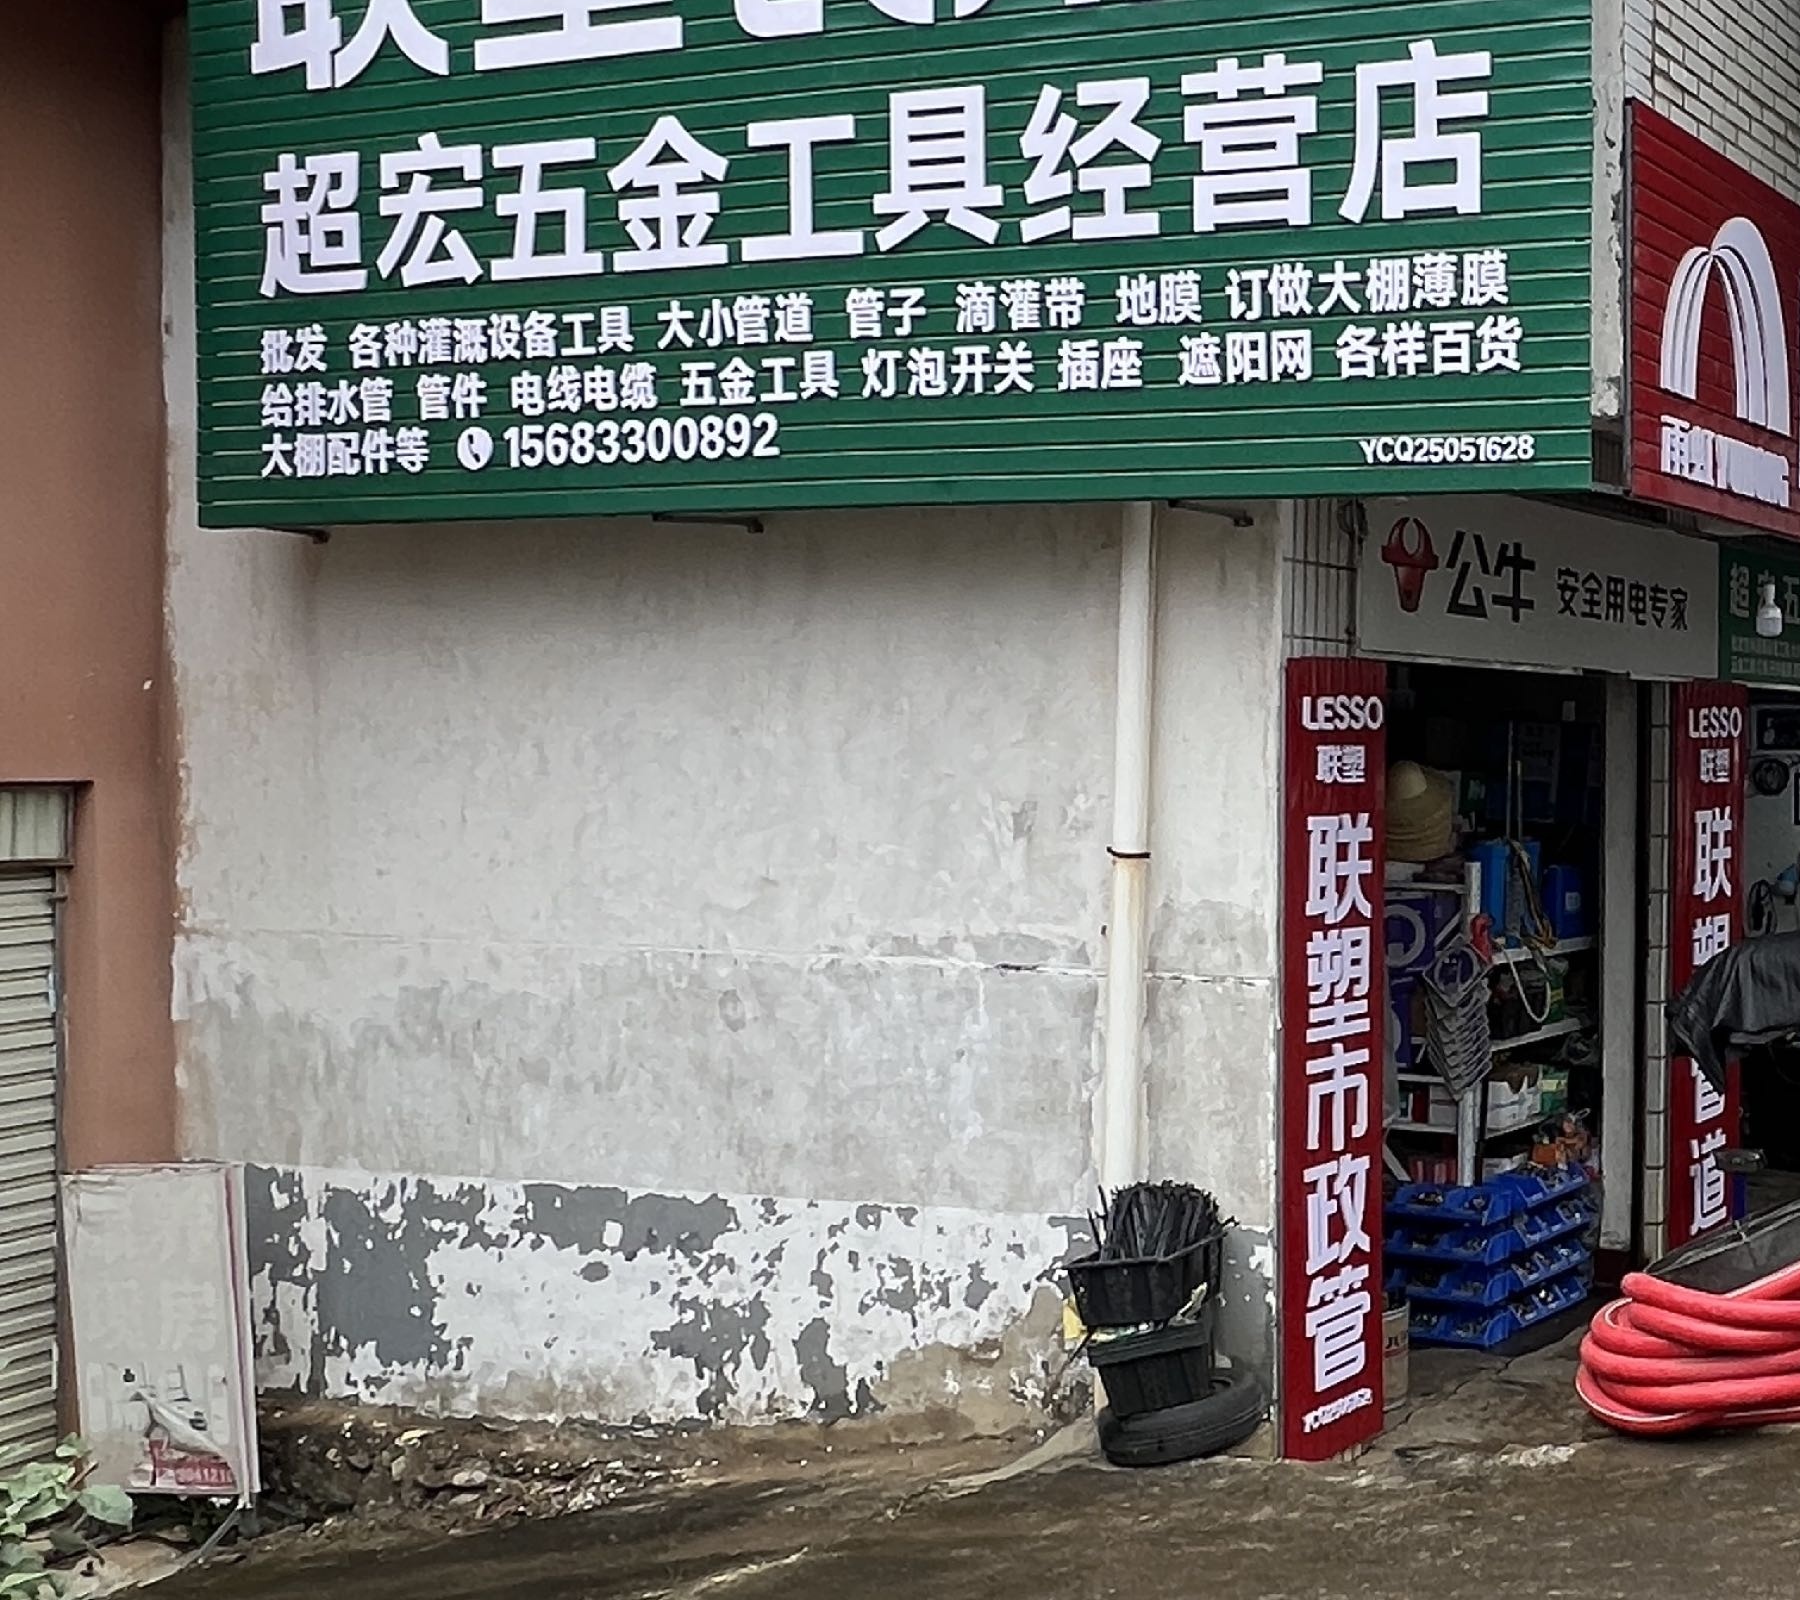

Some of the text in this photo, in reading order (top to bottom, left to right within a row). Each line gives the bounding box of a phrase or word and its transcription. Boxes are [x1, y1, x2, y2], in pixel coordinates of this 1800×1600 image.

[259, 38, 1491, 299] 超宏五金工具经营店
[261, 249, 1509, 374] 批发 各种灌溉设备工具 大小管道 管子 滴灌带 地膜 订做大棚薄膜
[261, 316, 1524, 427] 给排水管 管件 电线电缆 五金工具 灯泡开关 插座 遮阳网 各样百货
[261, 413, 781, 477] 大棚配件等 15683300892
[1360, 434, 1535, 466] YCQ25051628
[1446, 530, 1689, 631] 公牛 安全用电专家
[1302, 695, 1383, 732] LESSO
[1688, 706, 1743, 740] LESSO
[1316, 745, 1366, 785] 联塑
[1305, 813, 1374, 1393] 联塑市政管
